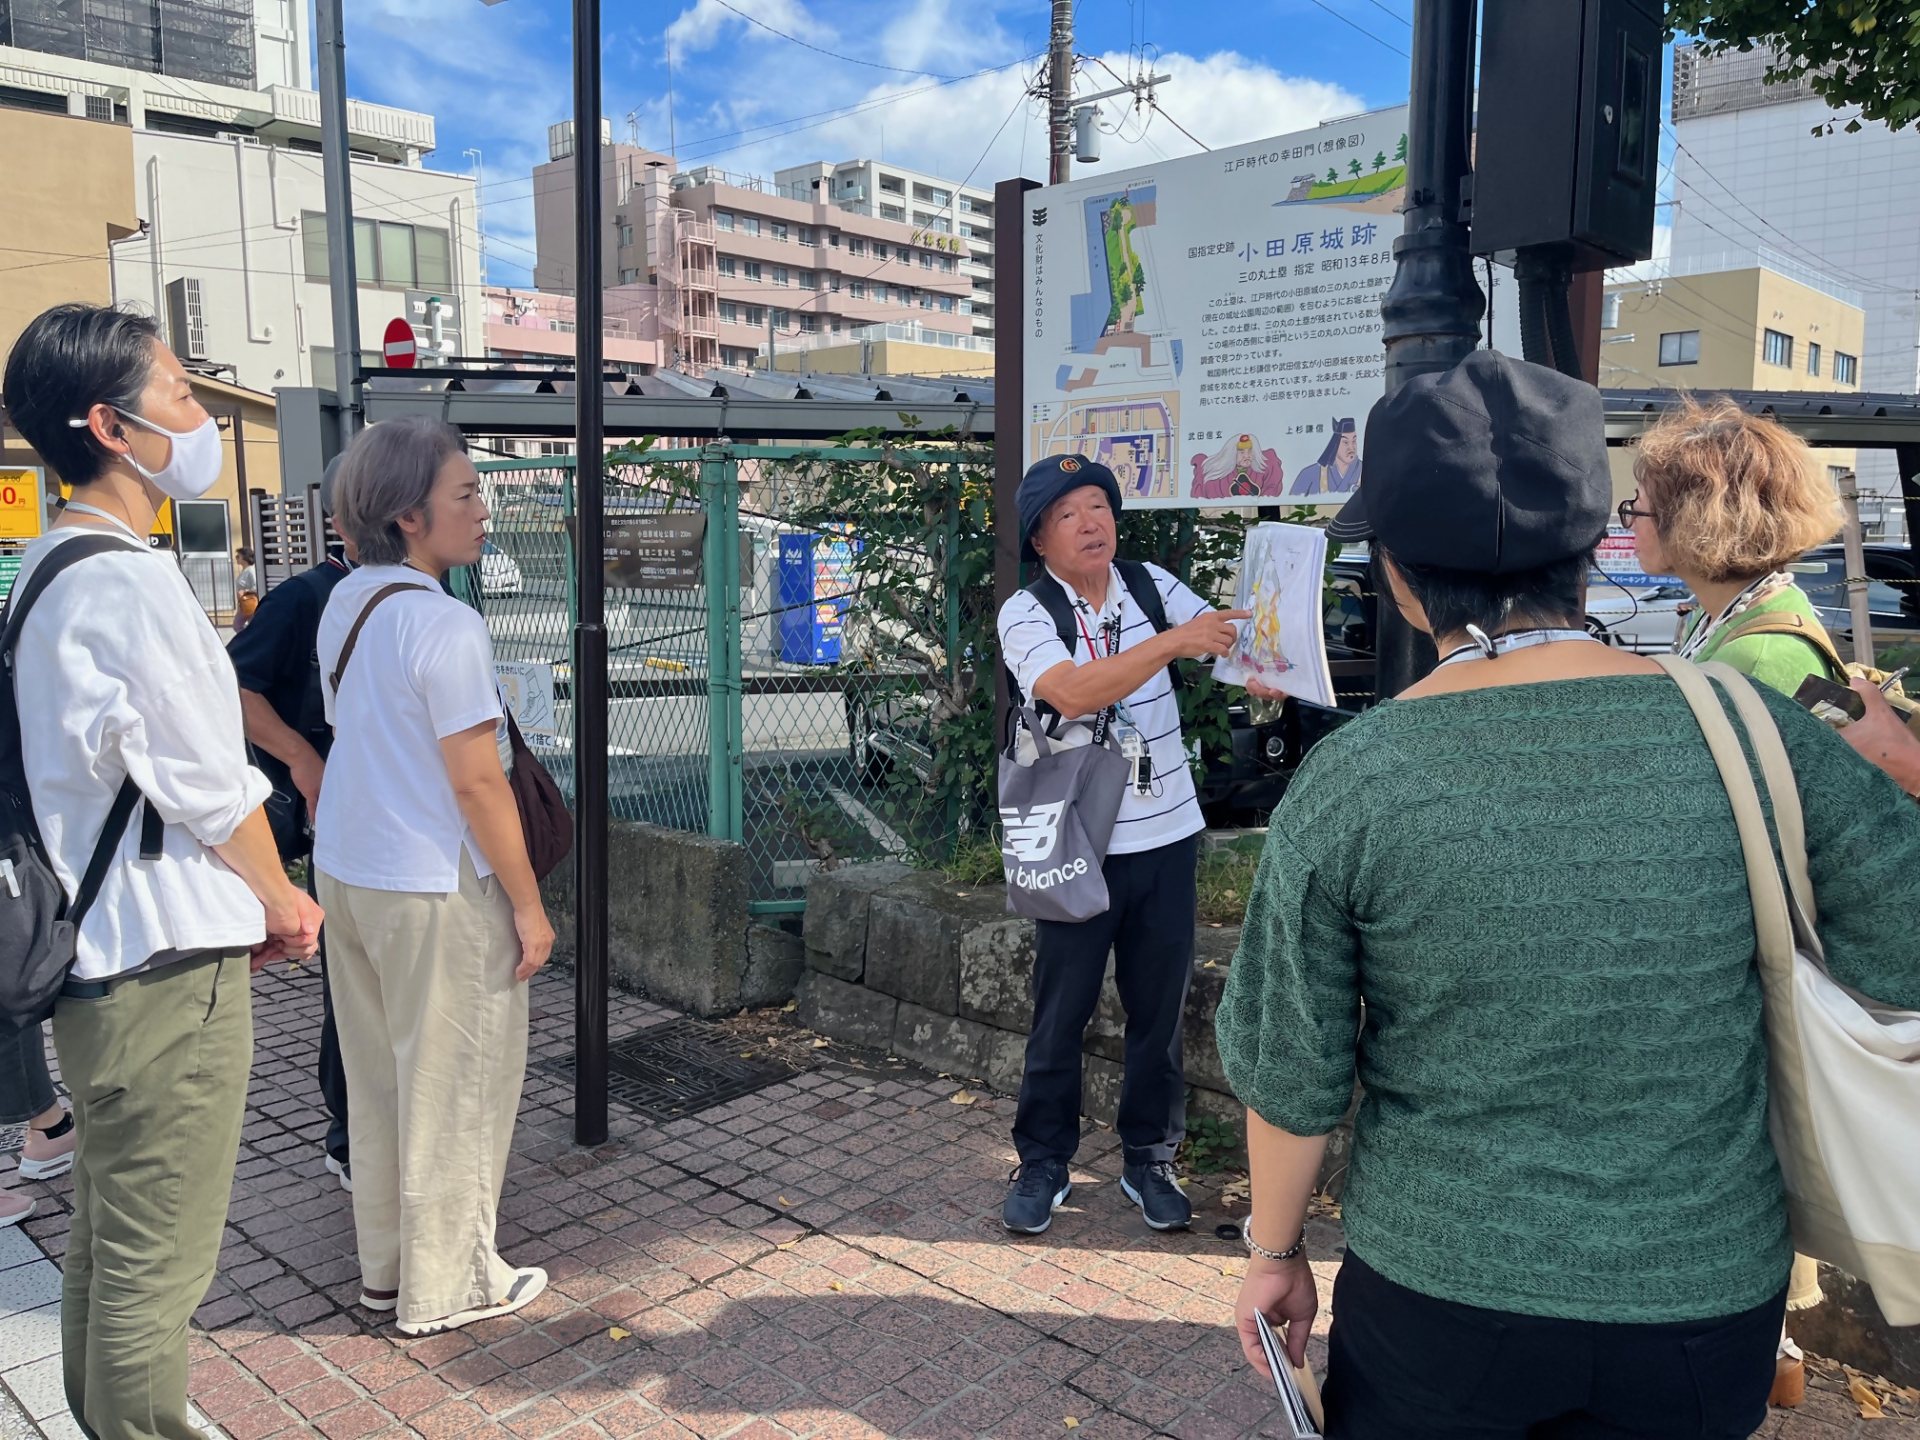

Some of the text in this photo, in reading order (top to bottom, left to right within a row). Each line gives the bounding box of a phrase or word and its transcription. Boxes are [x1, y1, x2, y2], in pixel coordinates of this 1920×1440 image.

[1224, 133, 1366, 173] 江戸時代の幸田門（想像図）
[1188, 222, 1378, 263] 国指定史跡 小田原城跡
[1238, 251, 1391, 284] 三の丸土塁 指定 昭和13年8月
[1034, 233, 1044, 338] 文化財はみんなのもの
[1208, 276, 1395, 308] この土塁は、江戸時代の小田原城の三の丸の土塁跡で
[1200, 349, 1282, 365] 調査で見つかっています。
[1188, 431, 1222, 441] 武田信玄
[1285, 424, 1324, 435] 上杉謙信
[494, 665, 525, 675] ちをきれいに
